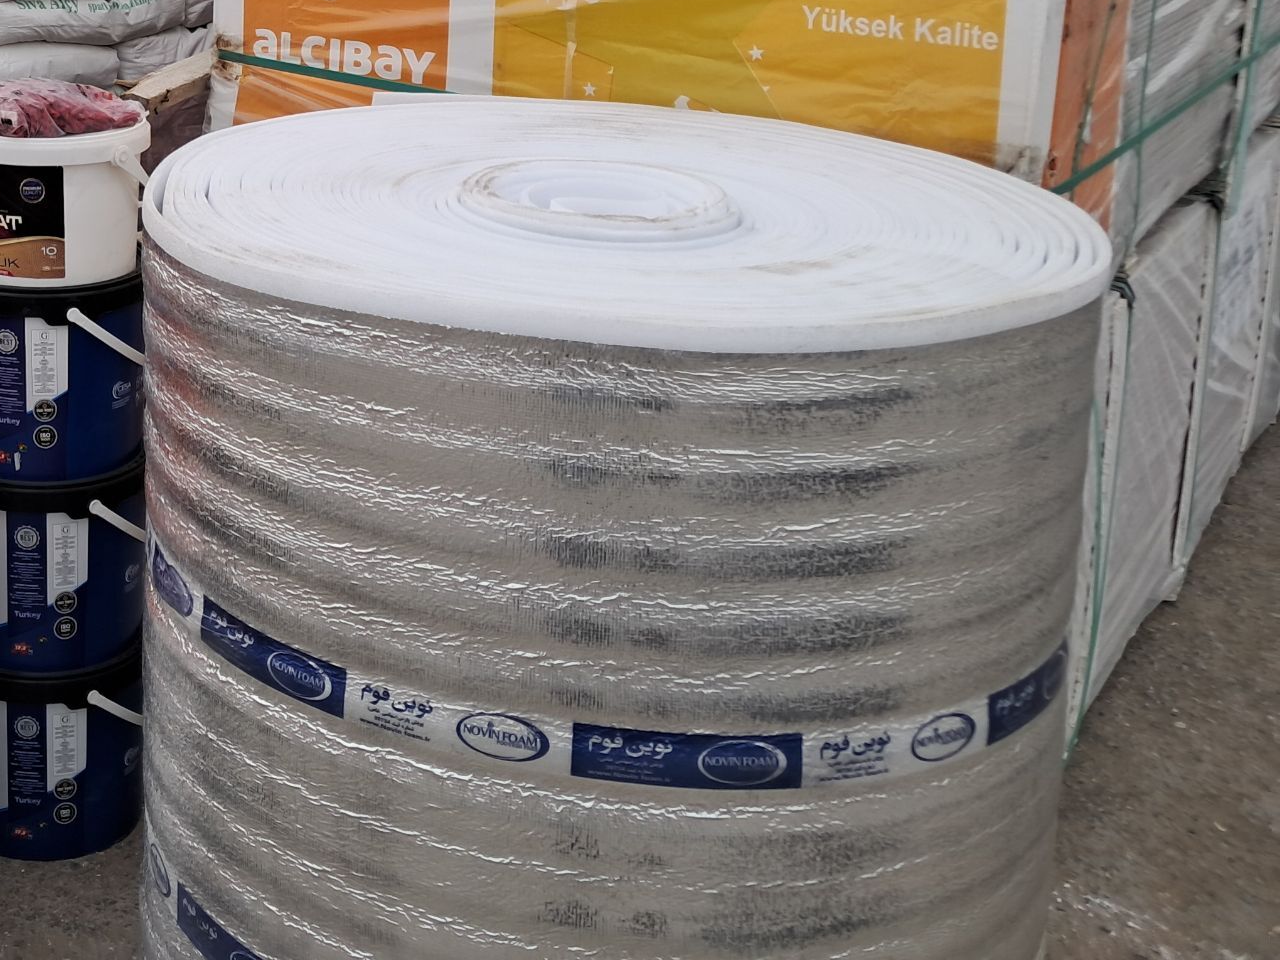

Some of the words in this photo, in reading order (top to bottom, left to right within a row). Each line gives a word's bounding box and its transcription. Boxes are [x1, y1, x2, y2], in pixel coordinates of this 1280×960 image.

[802, 4, 906, 42] Yüksek
[912, 14, 1000, 51] Kalite
[41, 246, 57, 256] 10
[19, 534, 35, 542] BEST
[14, 610, 42, 620] Turkey
[360, 683, 391, 705] فوم
[391, 698, 434, 719] نوین
[462, 721, 500, 741] NOVIN
[501, 730, 539, 749] FOAM
[587, 733, 624, 753] فوم
[624, 739, 673, 760] نوین
[703, 755, 742, 768] NOVIN
[742, 755, 777, 768] FOAM
[13, 796, 41, 807] Turkey
